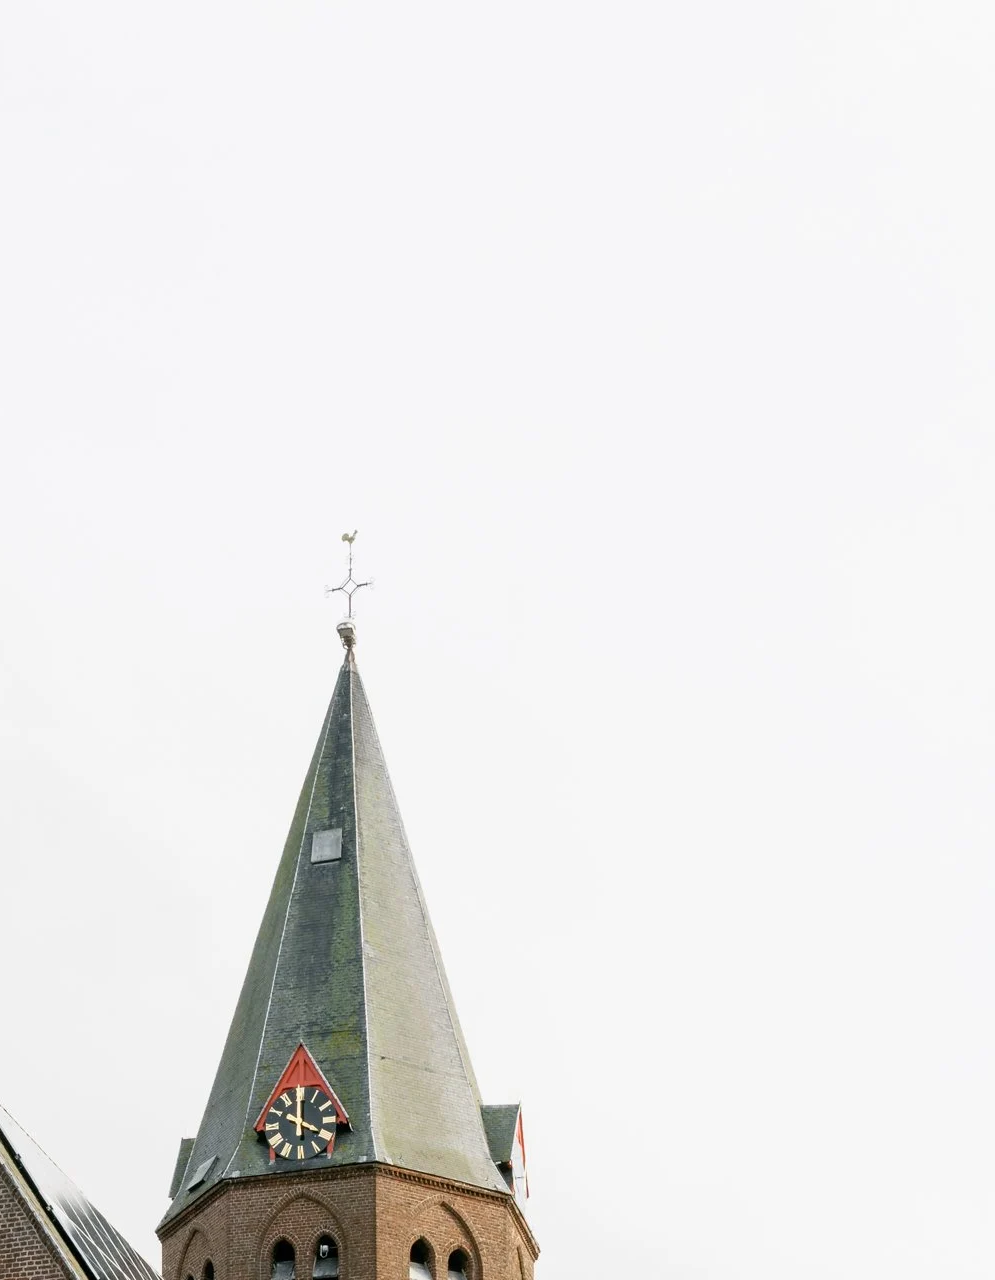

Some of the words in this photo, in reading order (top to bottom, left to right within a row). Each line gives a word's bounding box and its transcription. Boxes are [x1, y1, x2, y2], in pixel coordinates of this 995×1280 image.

[280, 1092, 292, 1107] XI
[310, 1090, 319, 1103] I
[269, 1107, 283, 1117] X
[318, 1100, 332, 1112] II
[266, 1122, 280, 1131] IX
[323, 1116, 337, 1124] III
[268, 1132, 284, 1149] VIII
[280, 1142, 292, 1158] VII
[297, 1145, 305, 1160] VI
[311, 1141, 321, 1154] V
